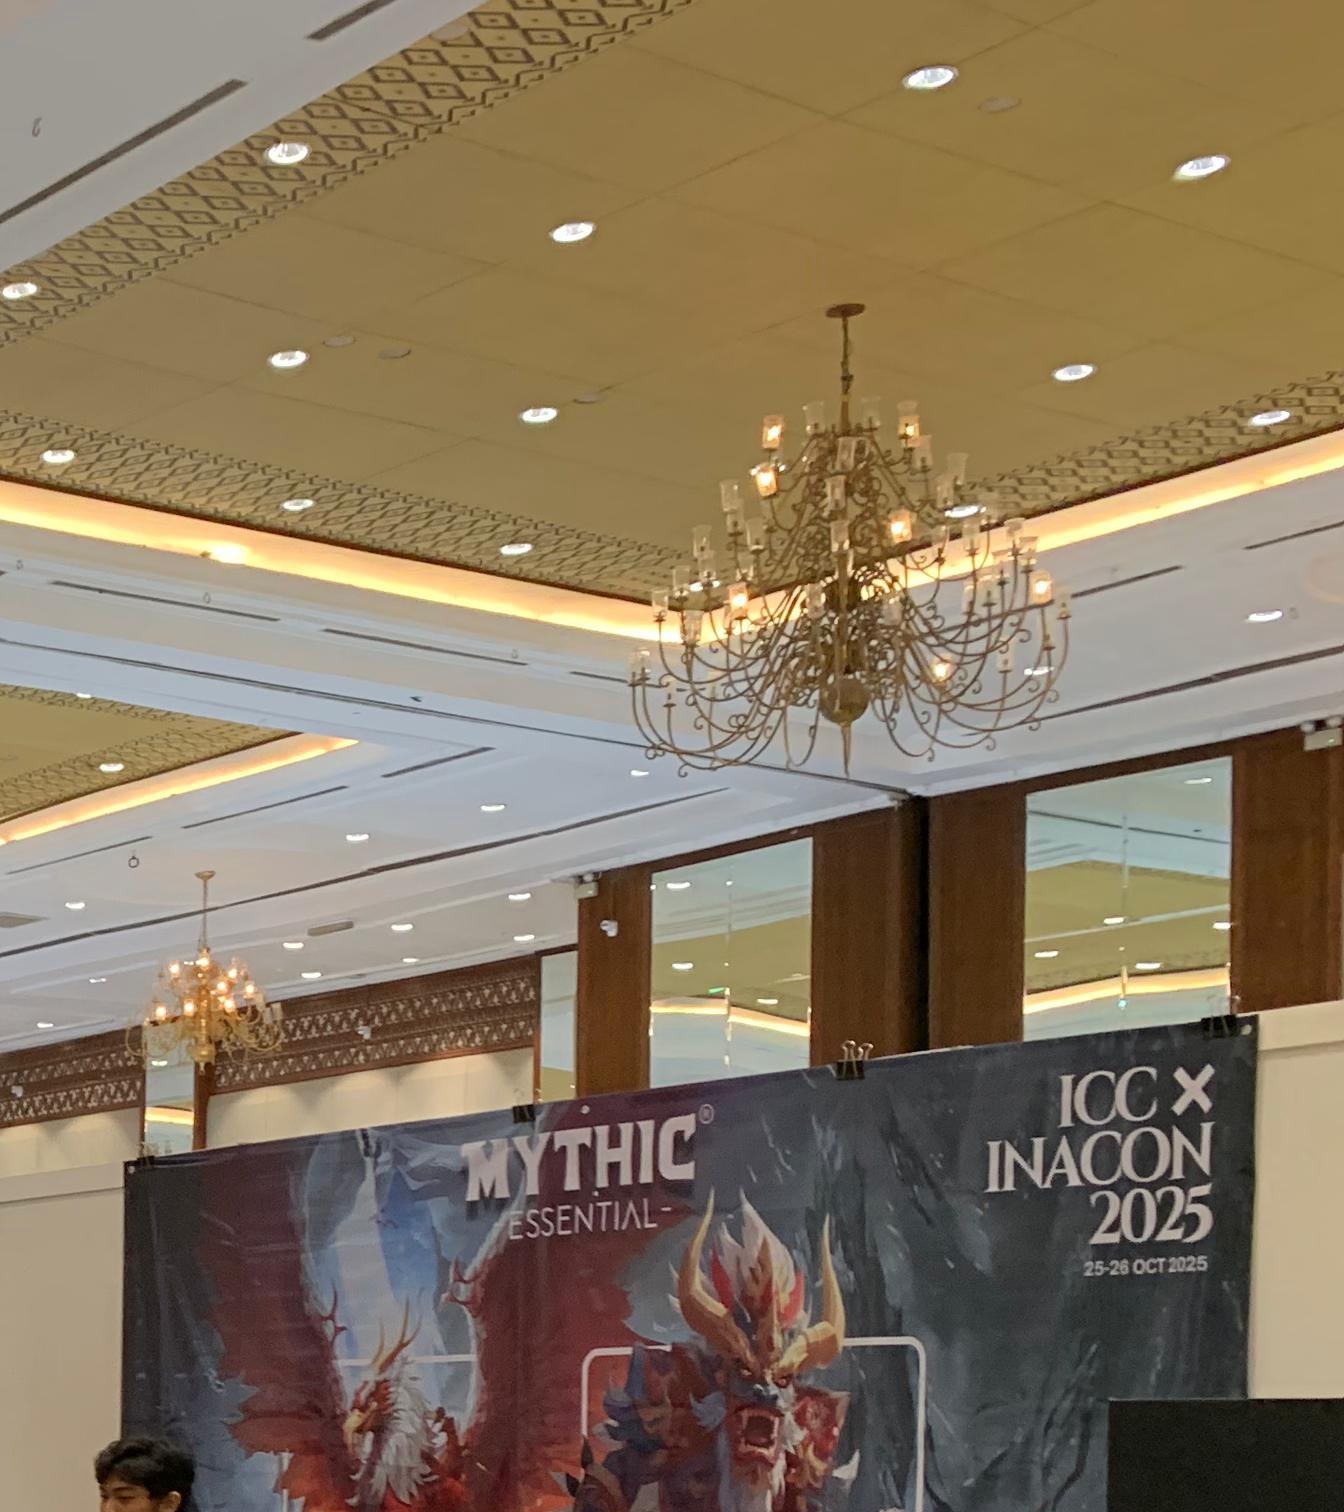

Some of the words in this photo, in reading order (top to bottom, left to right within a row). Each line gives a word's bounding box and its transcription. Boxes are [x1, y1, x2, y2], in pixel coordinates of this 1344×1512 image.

[1058, 1066, 1157, 1129] ICC
[983, 1122, 1215, 1194] INACON
[1089, 1183, 1213, 1246] 2025
[1084, 1259, 1129, 1277] 25-26
[1133, 1257, 1167, 1275] OCT
[1169, 1255, 1208, 1273] 2025
